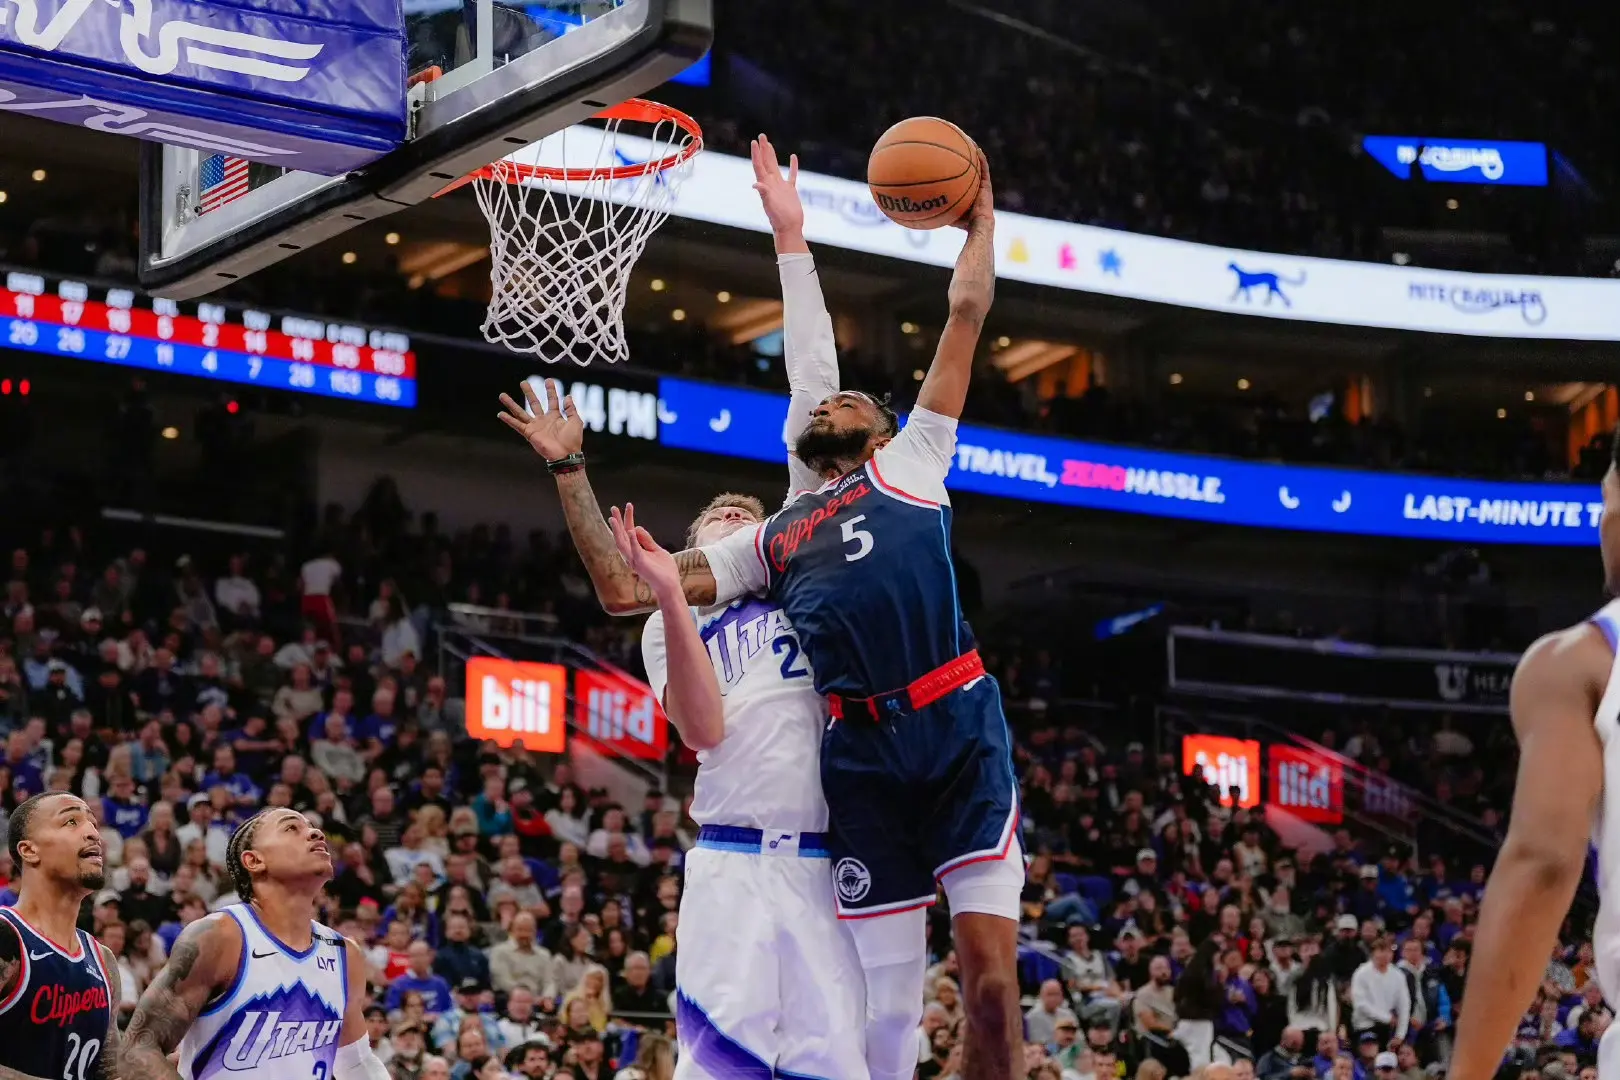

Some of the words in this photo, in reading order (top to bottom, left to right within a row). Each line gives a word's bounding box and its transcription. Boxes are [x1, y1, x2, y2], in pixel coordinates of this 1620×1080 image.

[876, 191, 948, 212] Wilson
[9, 319, 38, 346] 20
[201, 350, 218, 373] 4
[248, 356, 263, 379] 7
[202, 323, 219, 347] 2
[608, 387, 657, 440] PM
[957, 444, 1058, 488] TRAVEL,
[769, 483, 871, 573] Clippers
[1404, 493, 1582, 527] LAST-MINUTE
[839, 514, 874, 562] 5
[704, 607, 795, 697] UTA
[481, 675, 552, 735] bill
[31, 983, 108, 1028] Clippers
[63, 1032, 100, 1080] 20
